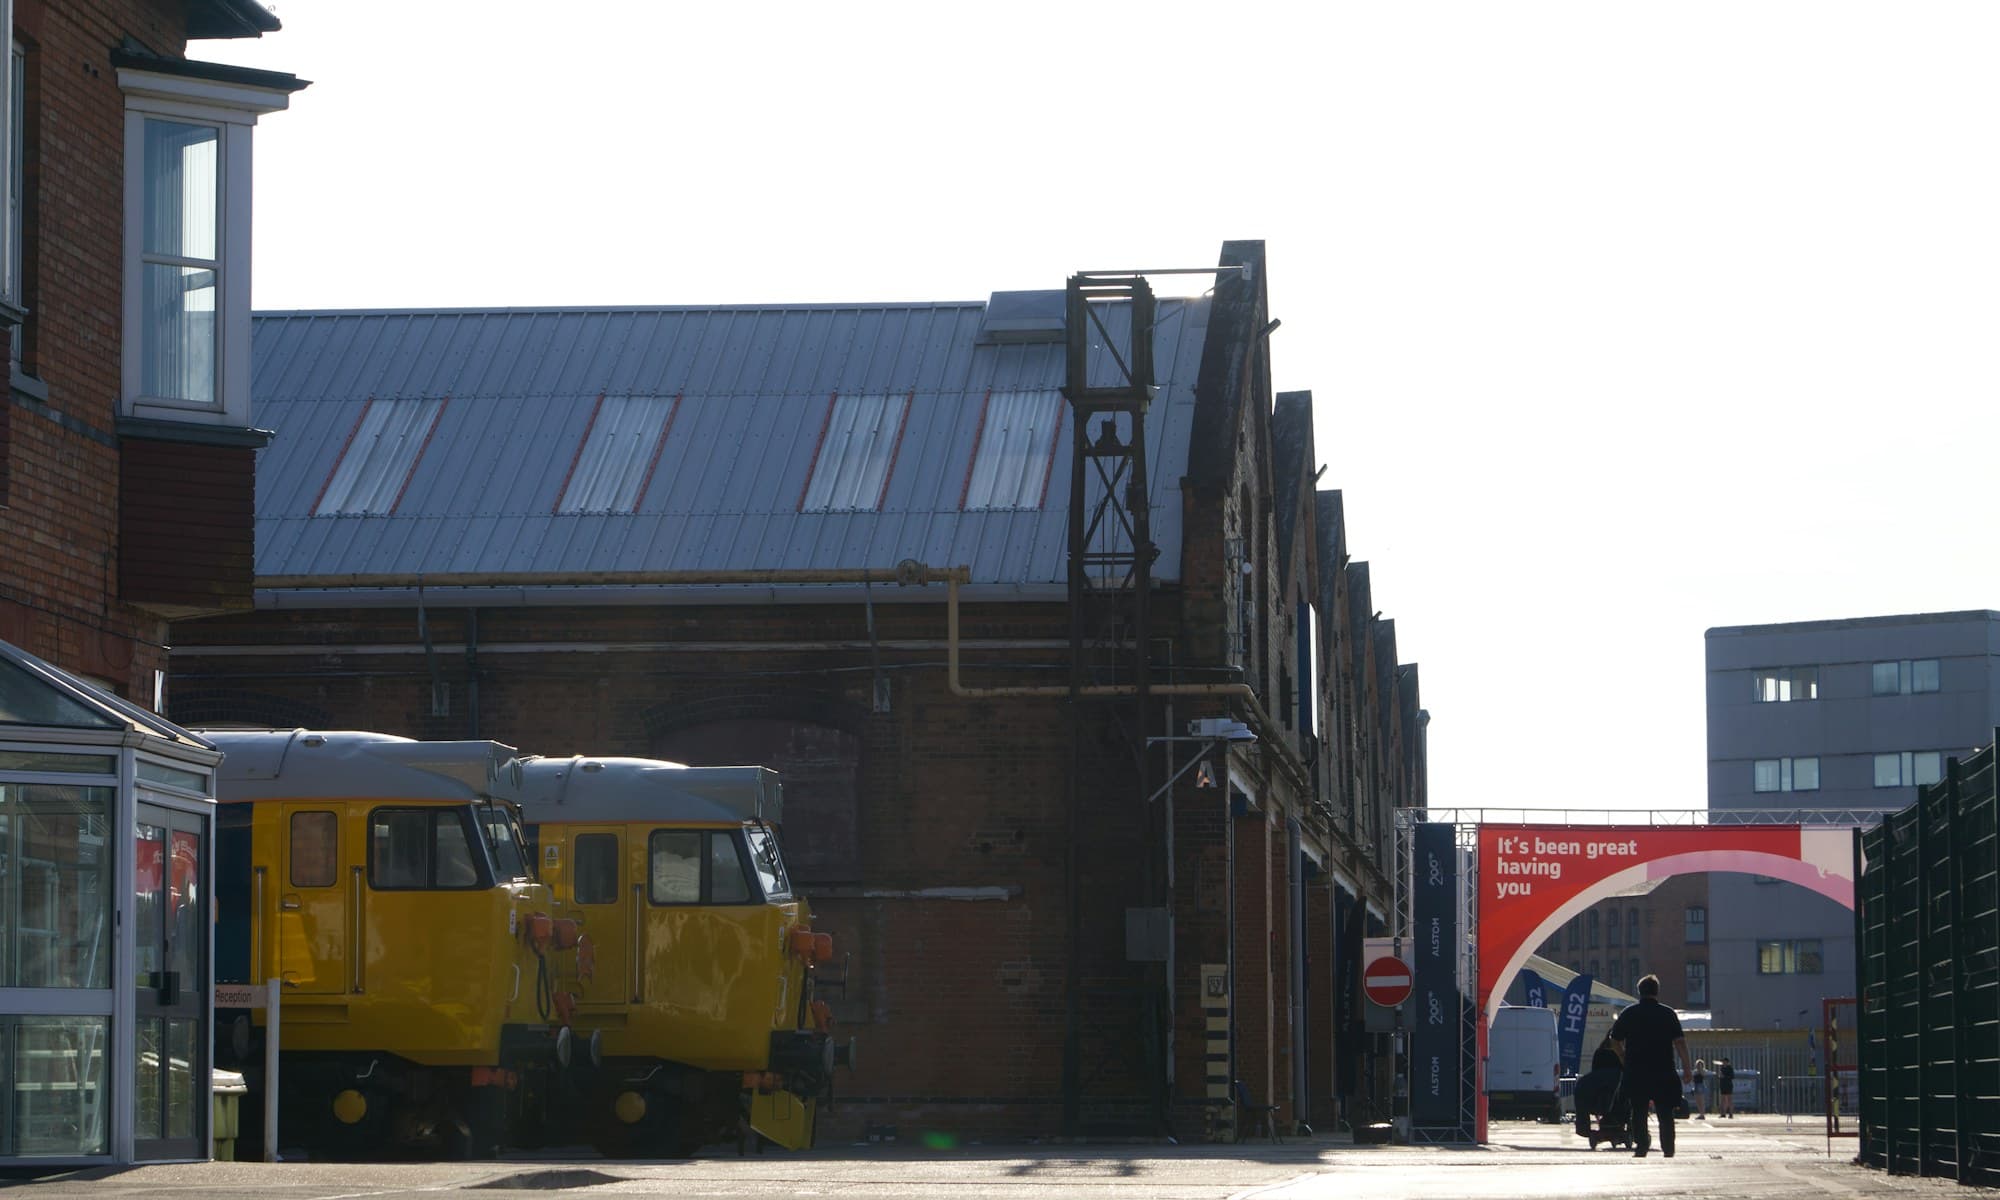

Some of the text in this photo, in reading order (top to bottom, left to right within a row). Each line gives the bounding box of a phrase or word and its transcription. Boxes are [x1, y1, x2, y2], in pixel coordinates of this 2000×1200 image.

[1196, 760, 1218, 789] A
[1535, 836, 1581, 855] been
[1586, 840, 1638, 860] great
[1497, 856, 1562, 880] having
[1496, 881, 1531, 900] you
[1431, 917, 1440, 957] ALSTOM
[216, 989, 252, 1006] Reception
[1529, 987, 1543, 1008] S2
[1564, 992, 1586, 1033] HS2
[1431, 1056, 1440, 1096] ALSTOM
